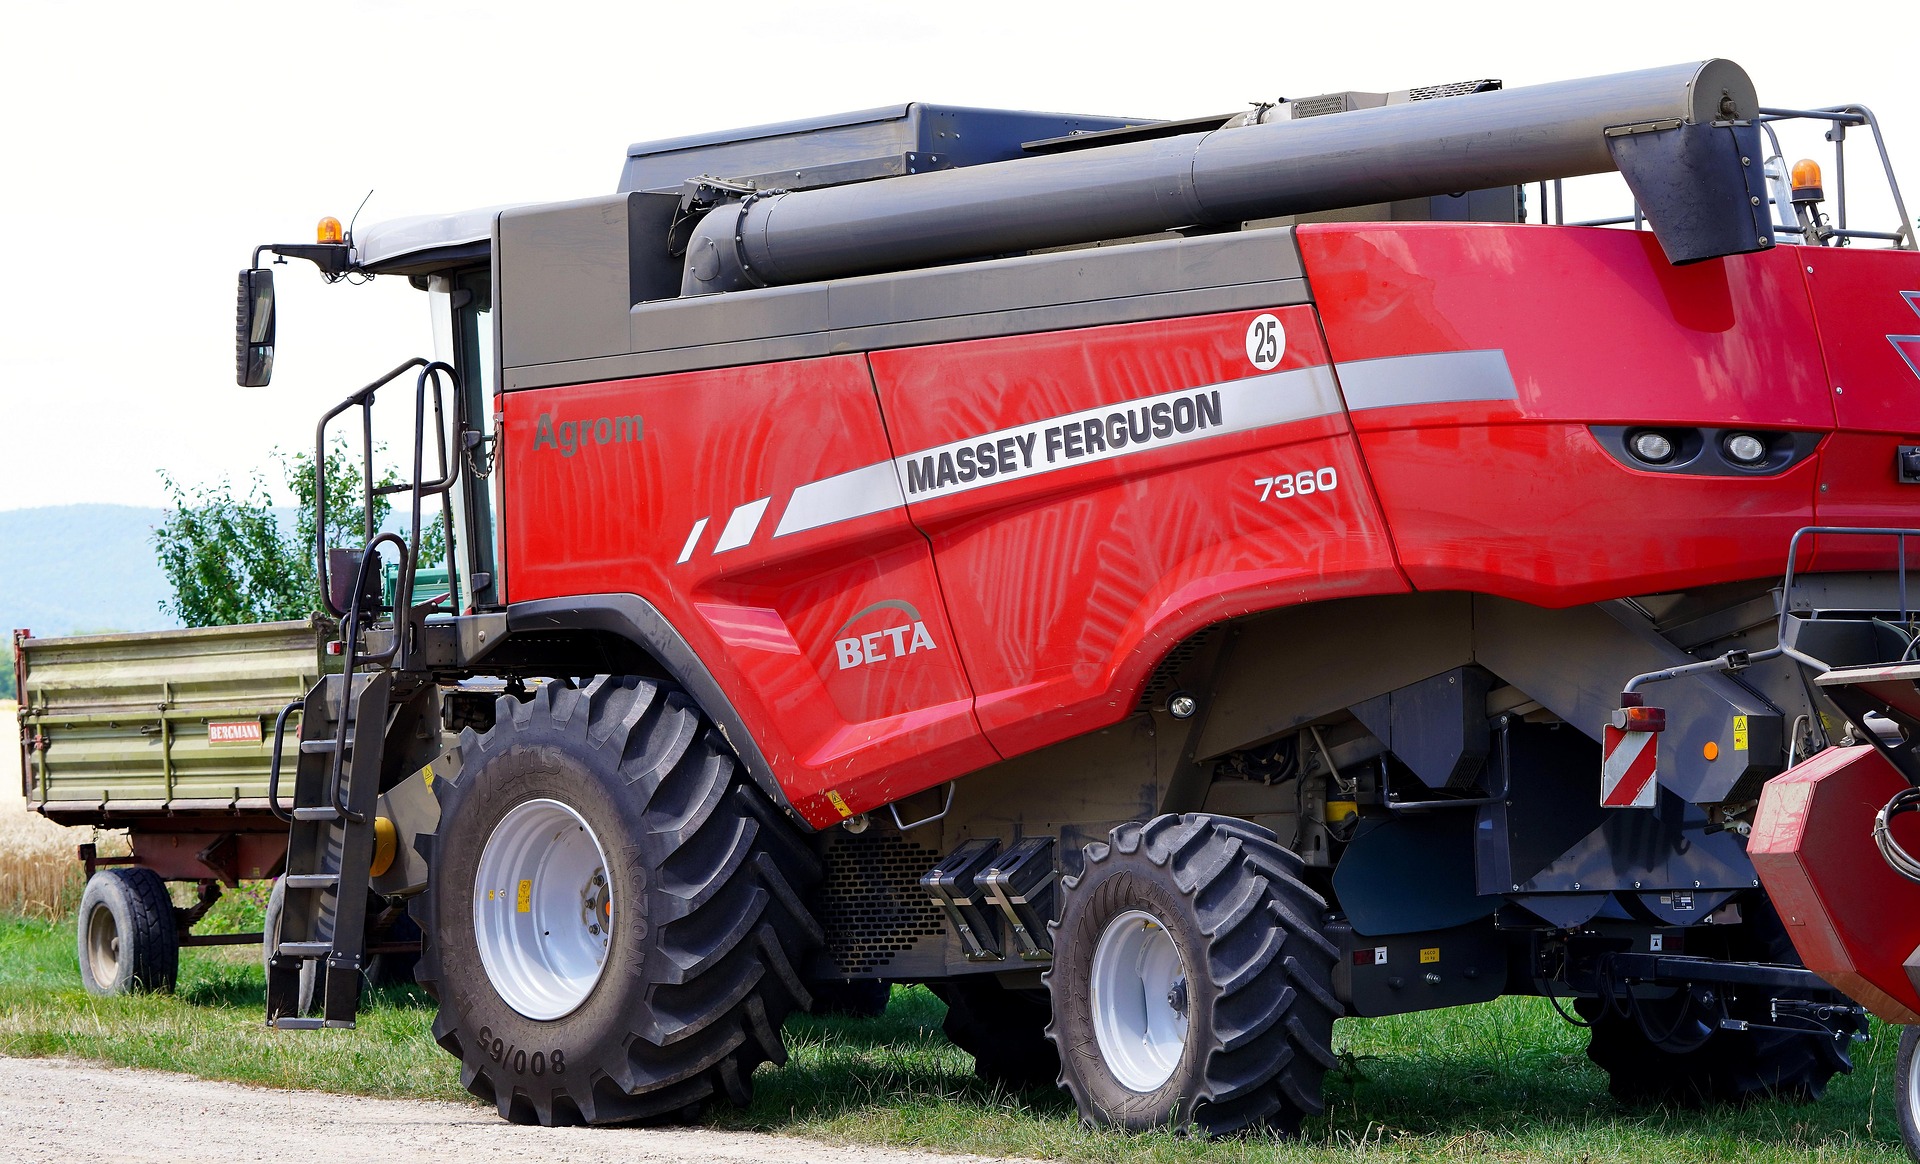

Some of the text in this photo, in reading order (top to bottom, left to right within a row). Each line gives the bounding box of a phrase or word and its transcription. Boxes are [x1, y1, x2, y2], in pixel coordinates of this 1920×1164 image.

[1254, 321, 1277, 364] 25
[533, 413, 644, 458] Agrom
[906, 390, 1223, 494] MASSEY FERGUSON
[1254, 466, 1338, 502] 7360
[835, 621, 937, 670] BETA
[210, 725, 259, 740] BERGMANN
[476, 1025, 566, 1078] 800/65
